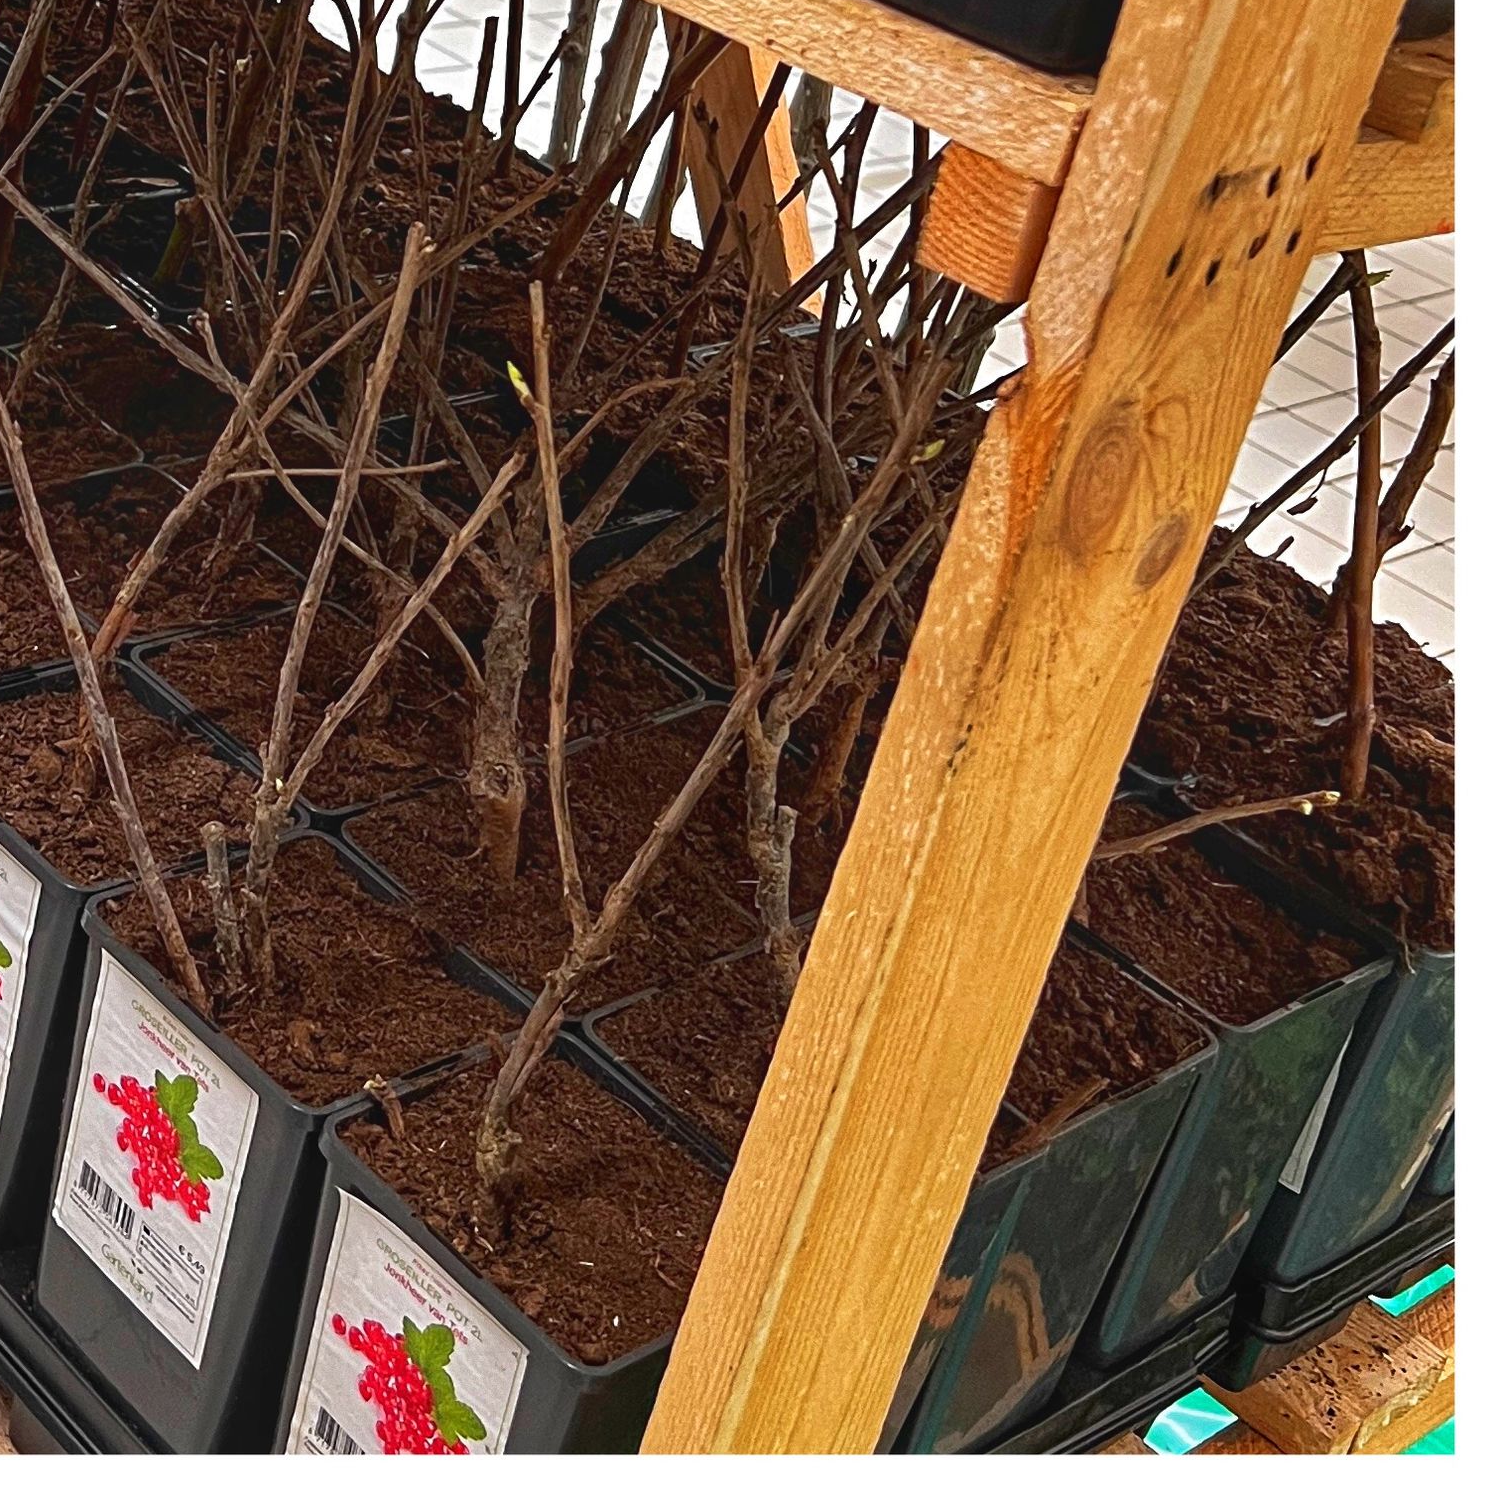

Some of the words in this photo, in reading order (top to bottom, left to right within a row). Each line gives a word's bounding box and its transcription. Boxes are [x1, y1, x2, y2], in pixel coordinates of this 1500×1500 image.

[191, 1053, 211, 1076] POT
[428, 1304, 446, 1324] van
[446, 1302, 470, 1326] POT
